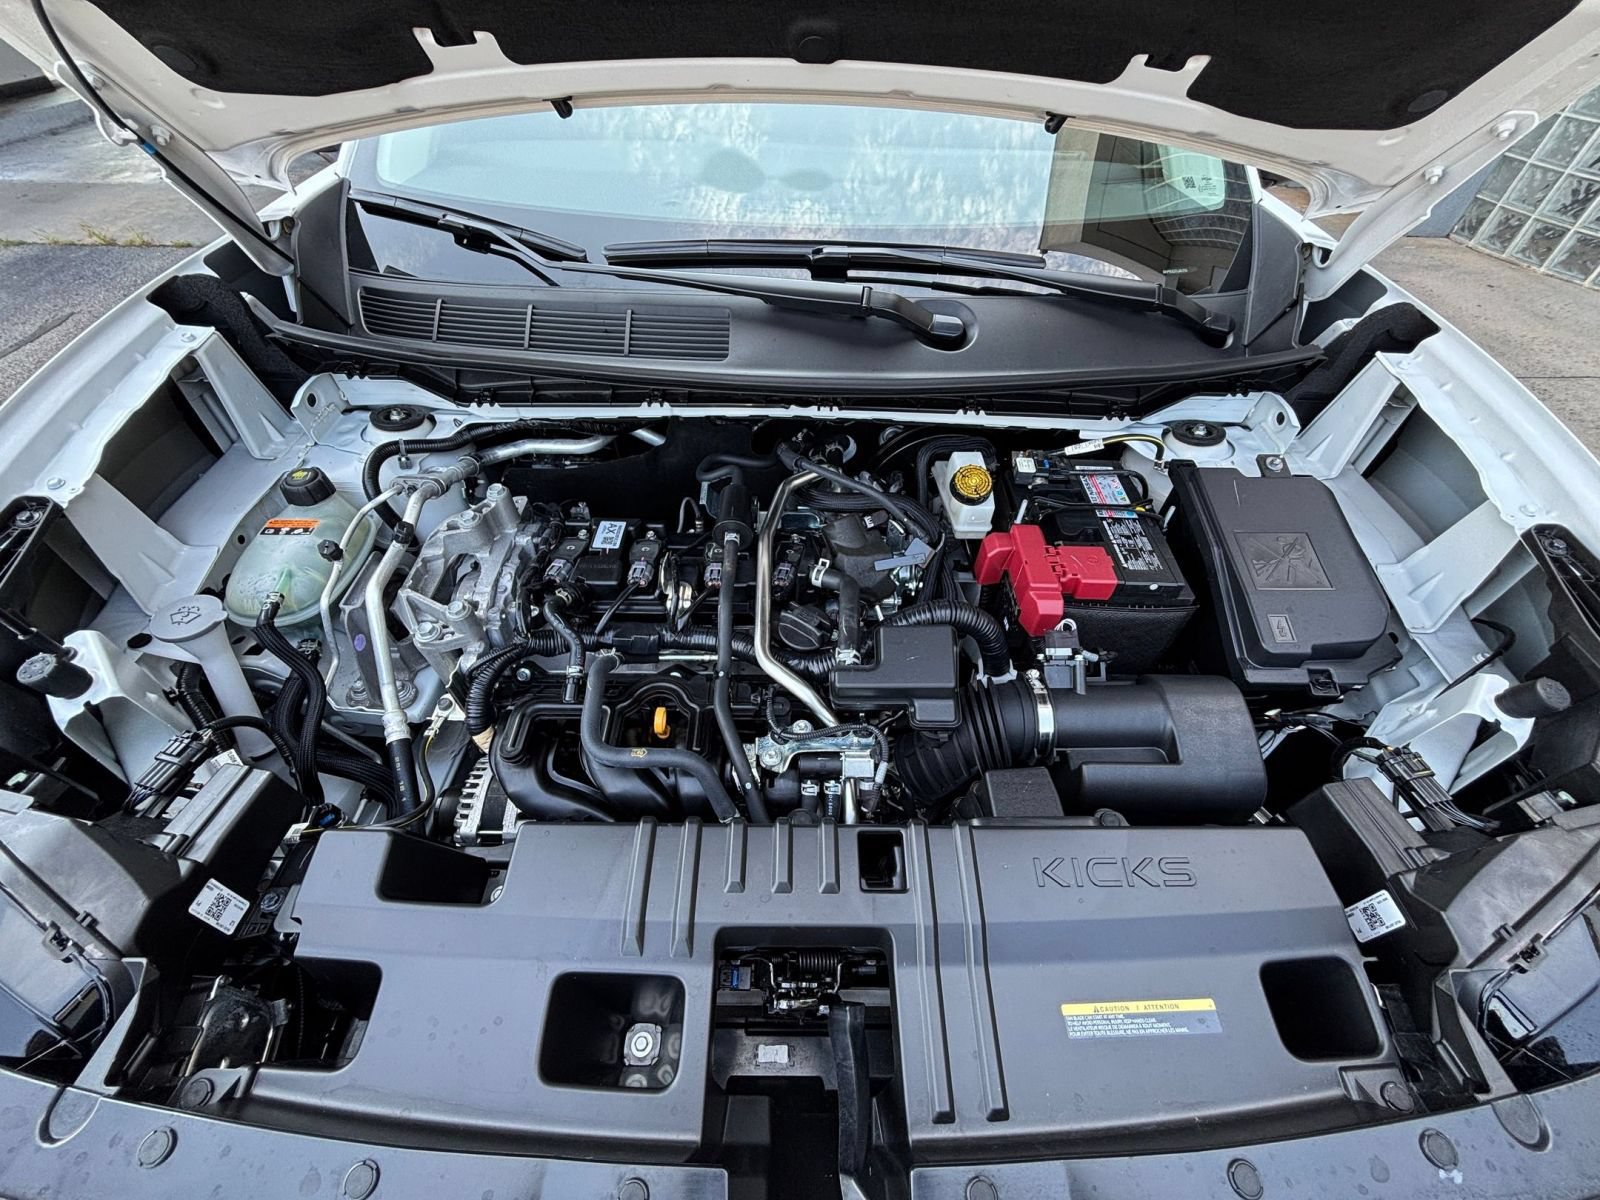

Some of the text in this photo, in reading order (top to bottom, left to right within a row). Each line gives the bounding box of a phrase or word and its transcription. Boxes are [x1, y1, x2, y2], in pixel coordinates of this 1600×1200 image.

[1033, 856, 1198, 888] KICKS
[1100, 1005, 1130, 1013] CAUTION
[1143, 1003, 1180, 1011] ATTENTION
